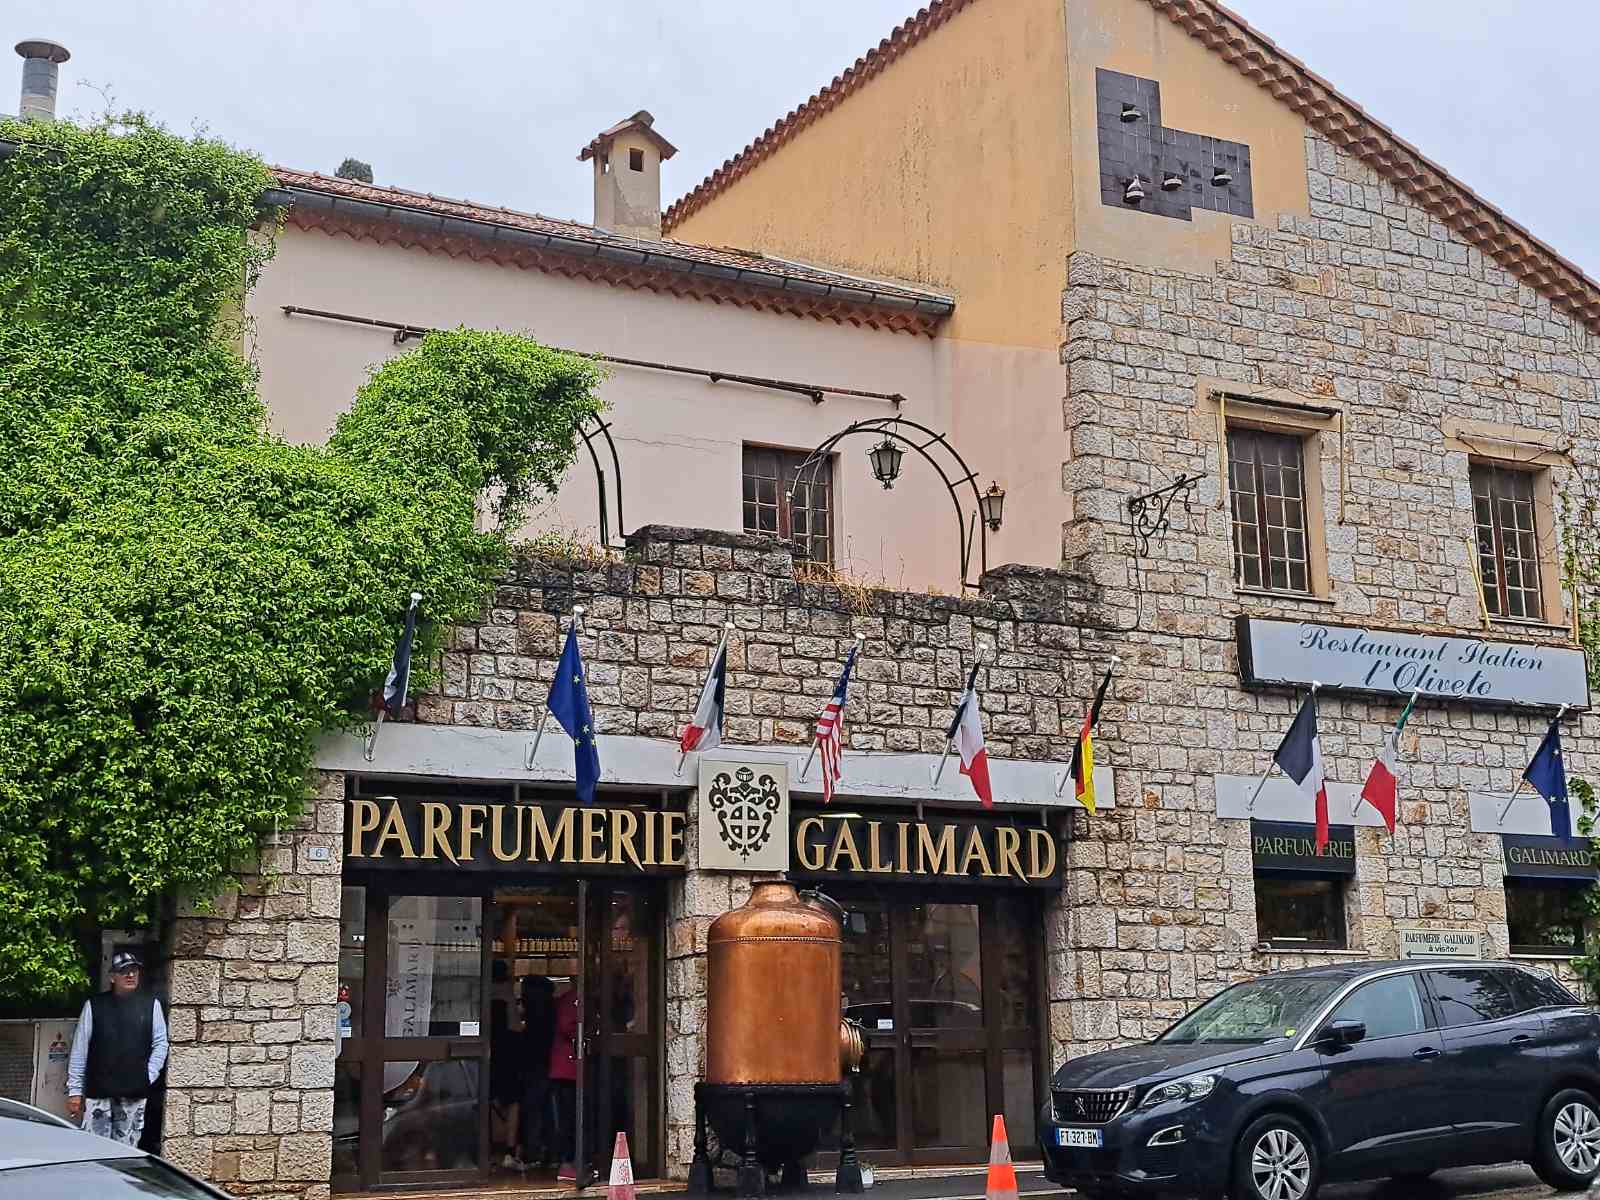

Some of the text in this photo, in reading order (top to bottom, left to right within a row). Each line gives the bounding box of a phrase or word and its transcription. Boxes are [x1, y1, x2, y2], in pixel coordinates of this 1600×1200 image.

[1299, 626, 1544, 671] Restaurant Italien
[347, 799, 686, 872] PARFUMERIE
[796, 817, 1057, 884] GALIMARD
[1508, 846, 1592, 866] GALIMARD
[1443, 934, 1475, 945] GALIMARD
